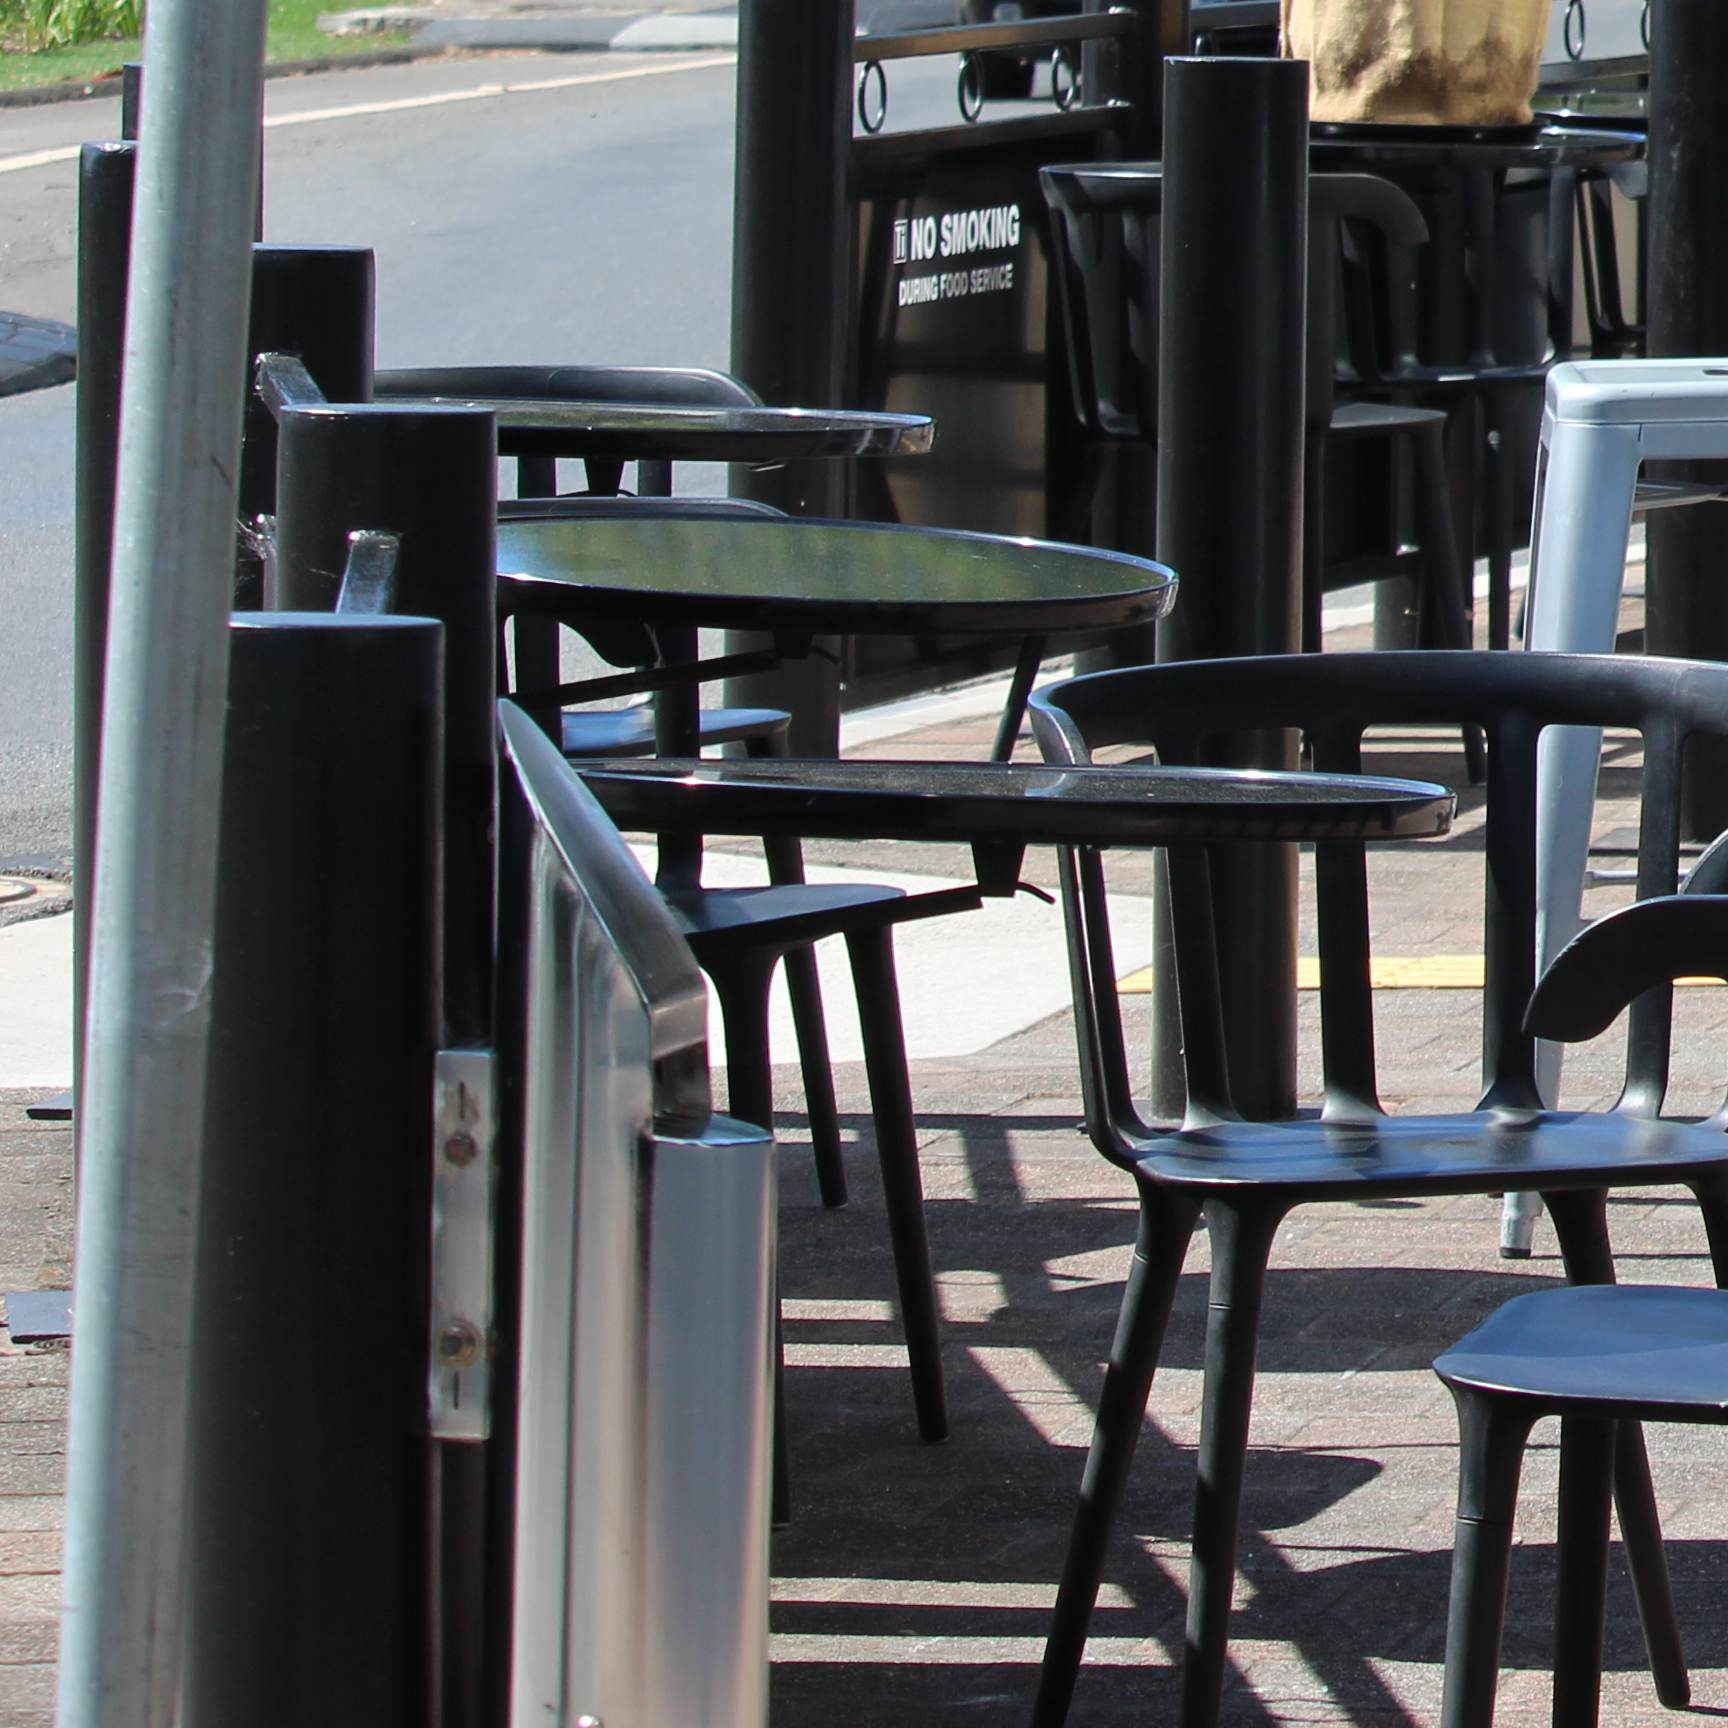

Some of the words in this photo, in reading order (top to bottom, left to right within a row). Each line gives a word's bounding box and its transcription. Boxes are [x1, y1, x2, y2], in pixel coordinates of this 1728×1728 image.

[910, 216, 937, 261] NO
[940, 204, 1020, 257] SMOKING
[898, 275, 938, 306] DURING
[940, 272, 968, 299] FOOD
[970, 263, 1013, 294] SERVICE
